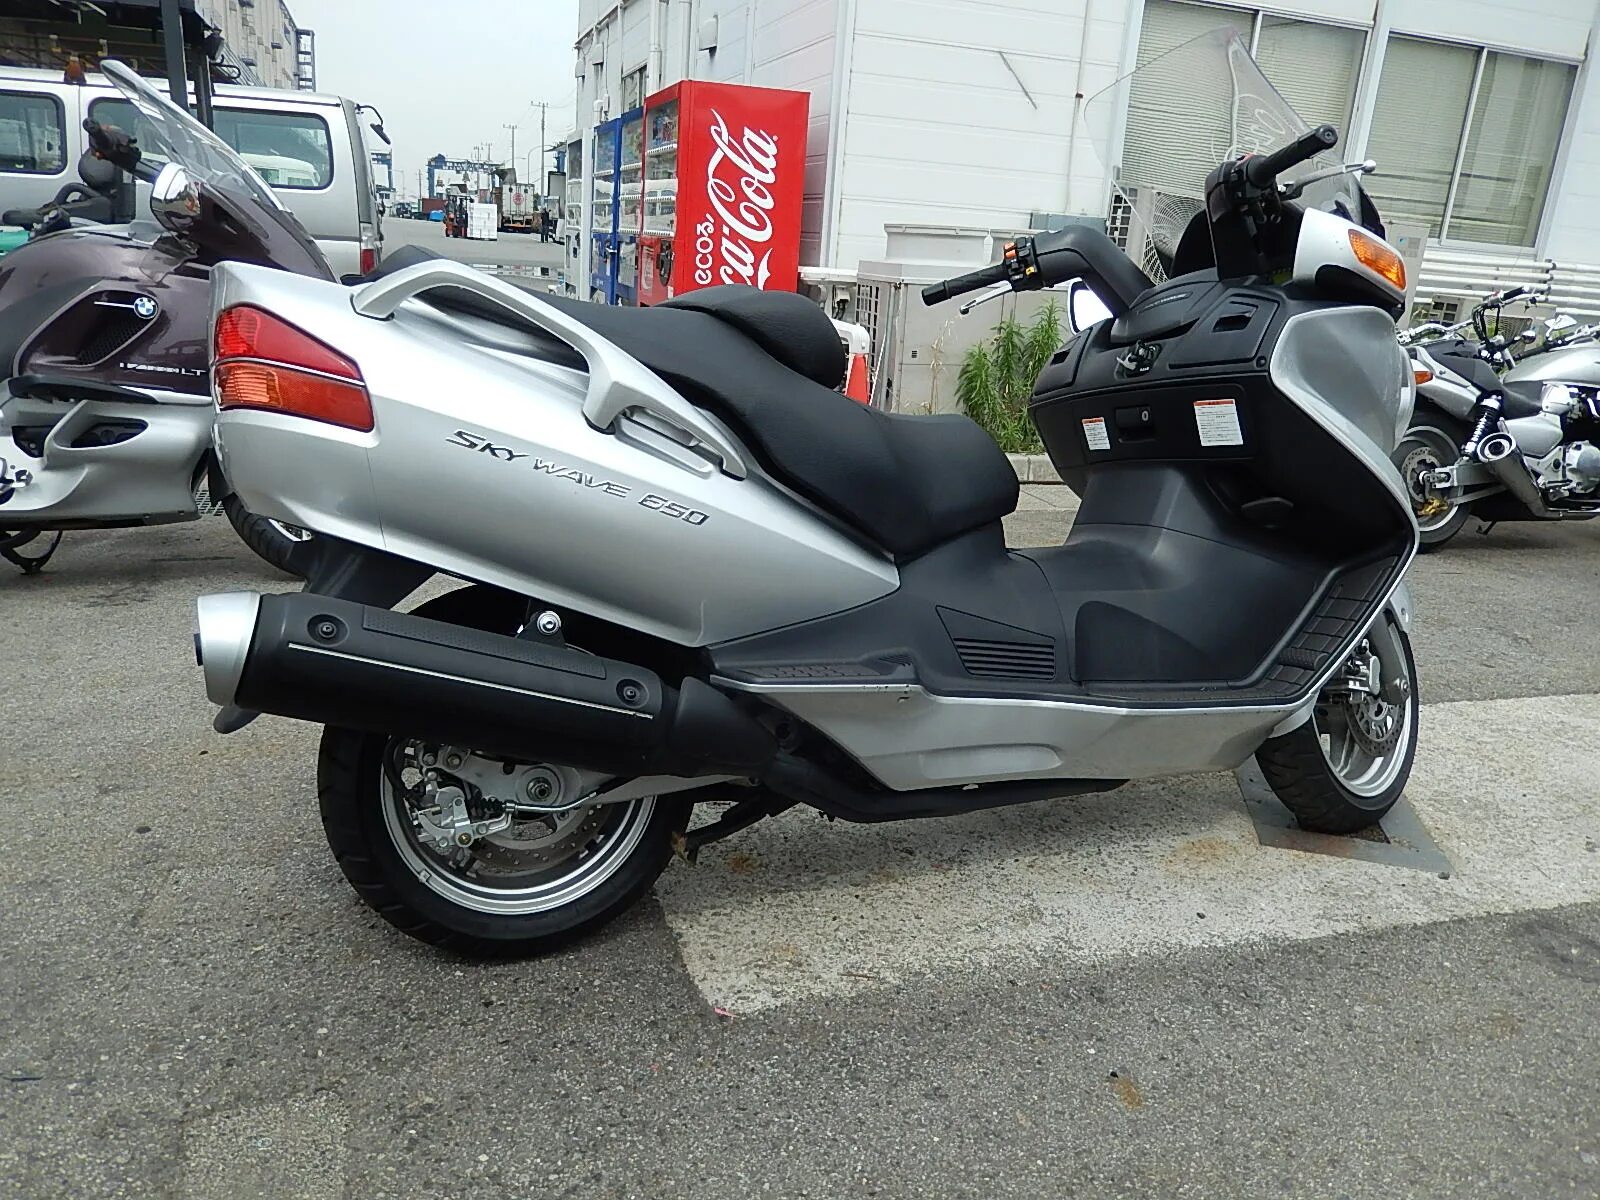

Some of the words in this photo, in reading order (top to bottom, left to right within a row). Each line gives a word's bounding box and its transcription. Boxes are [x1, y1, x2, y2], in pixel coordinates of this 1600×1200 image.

[446, 428, 530, 462] SKY
[533, 456, 632, 498] WAVE
[638, 493, 710, 526] 650
